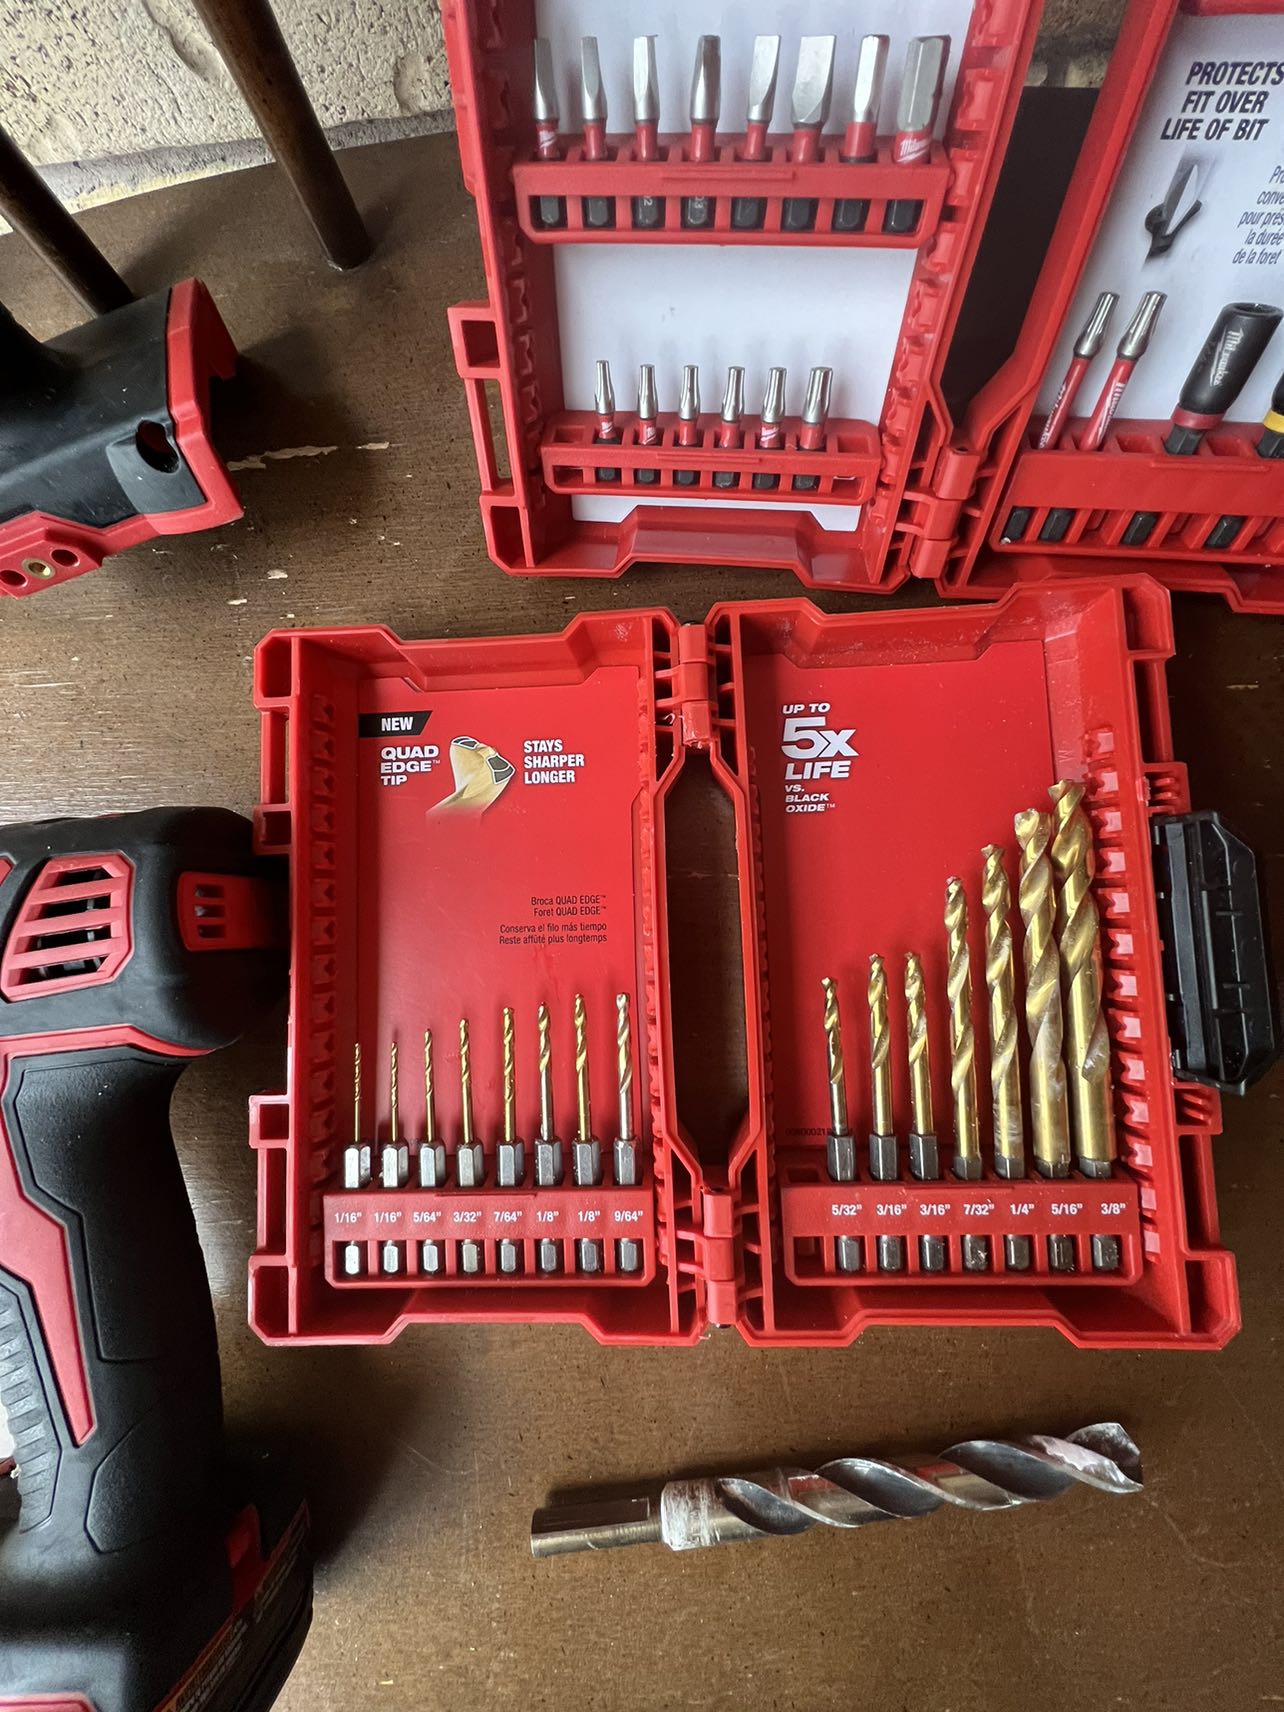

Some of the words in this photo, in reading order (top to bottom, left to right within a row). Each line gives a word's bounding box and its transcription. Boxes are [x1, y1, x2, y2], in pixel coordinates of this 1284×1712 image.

[1185, 61, 1284, 85] PROTECTS
[1181, 90, 1215, 114] FIT
[1215, 90, 1270, 114] OVER
[1160, 118, 1204, 140] LIFE
[1204, 118, 1234, 141] OF
[1232, 118, 1270, 141] BIT
[1237, 211, 1265, 229] pour
[1244, 228, 1256, 245] la
[1232, 248, 1247, 264] de
[1244, 248, 1257, 264] la
[1255, 248, 1282, 265] foret
[782, 704, 805, 714] UP
[808, 703, 830, 713] TO
[381, 717, 414, 731] NEW
[380, 745, 440, 760] QUAD
[523, 739, 563, 753] STAYS
[523, 754, 585, 769] SHARPER
[524, 770, 576, 784] LONGER
[785, 760, 851, 780] LIFE
[380, 774, 408, 786] TIP
[785, 793, 830, 803] BLACK
[531, 896, 554, 906] Broca
[555, 895, 577, 905] QUAD
[533, 907, 554, 917] Foret
[555, 906, 578, 916] QUAD
[500, 923, 536, 933] Conserva
[537, 923, 545, 932] el
[547, 923, 559, 932] filo
[561, 921, 578, 932] más
[580, 922, 607, 933] tiempo
[499, 935, 521, 945] Reste
[547, 934, 564, 945] plus
[566, 934, 608, 945] longtemps
[831, 1203, 863, 1216] 5/32"
[876, 1203, 907, 1216] 3/16"
[919, 1203, 950, 1216] 3/16"
[963, 1203, 995, 1215] 7/32"
[1010, 1203, 1035, 1215] 1/4"
[1051, 1202, 1083, 1215] 5/16"
[1101, 1202, 1126, 1215] 3/8"
[334, 1211, 363, 1223] 1/16"
[374, 1211, 402, 1223] 1/16"
[413, 1211, 442, 1223] 5/64"
[453, 1211, 482, 1222] 3/32"
[493, 1211, 523, 1222] 7/64"
[536, 1211, 559, 1222] 1/8"
[577, 1211, 600, 1222] 1/8"
[614, 1210, 643, 1222] 9/64"
